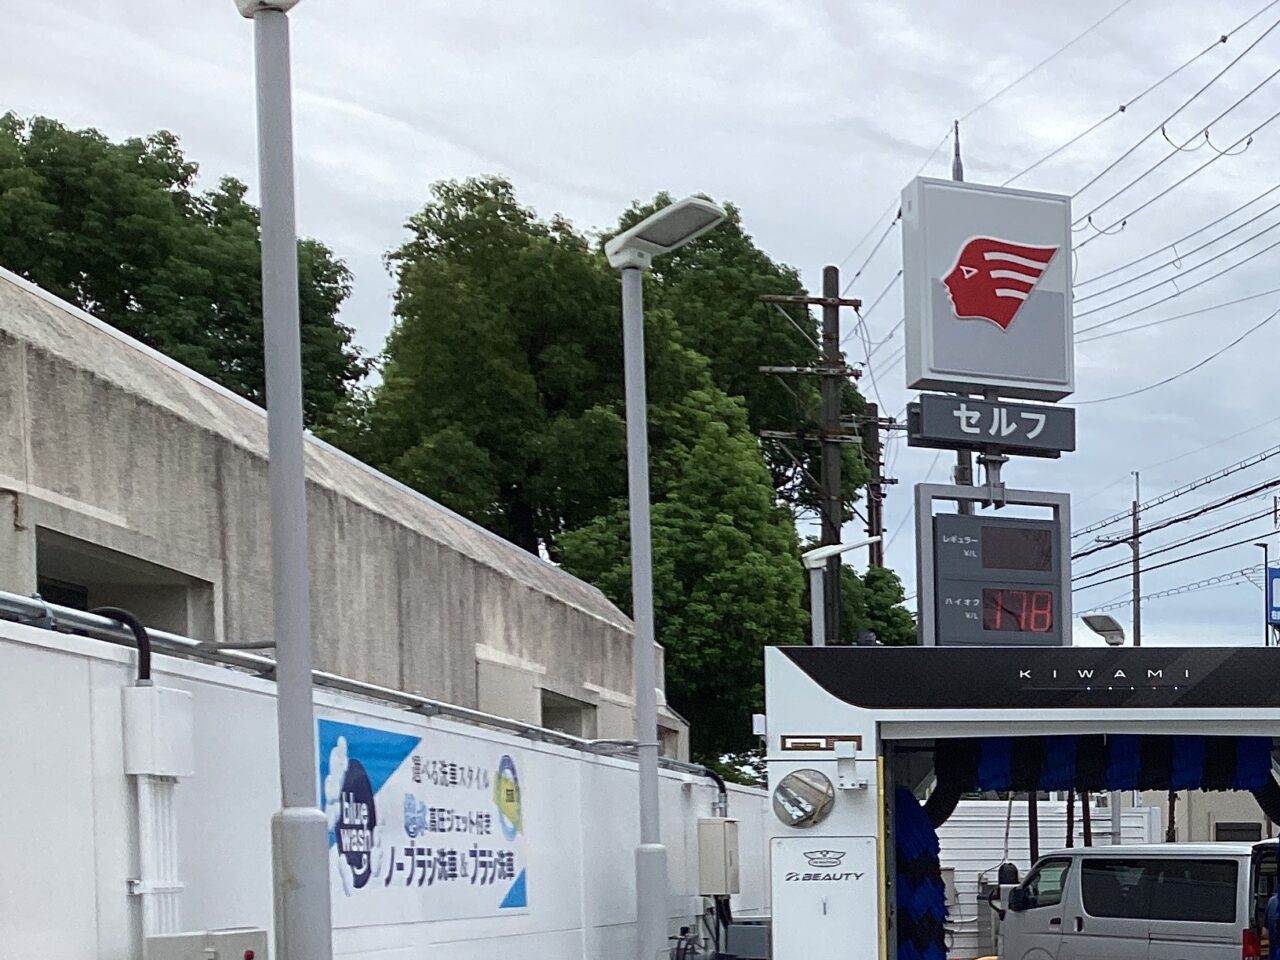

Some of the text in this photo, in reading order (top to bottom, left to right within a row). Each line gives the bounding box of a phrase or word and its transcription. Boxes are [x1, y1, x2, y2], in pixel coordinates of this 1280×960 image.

[953, 403, 1046, 439] セルフ
[943, 536, 979, 545] レギュラー
[994, 591, 1052, 632] 178
[1019, 669, 1189, 679] KIWAMI
[342, 792, 368, 824] blue
[340, 824, 371, 851] wash
[802, 873, 864, 881] BEAUTY
